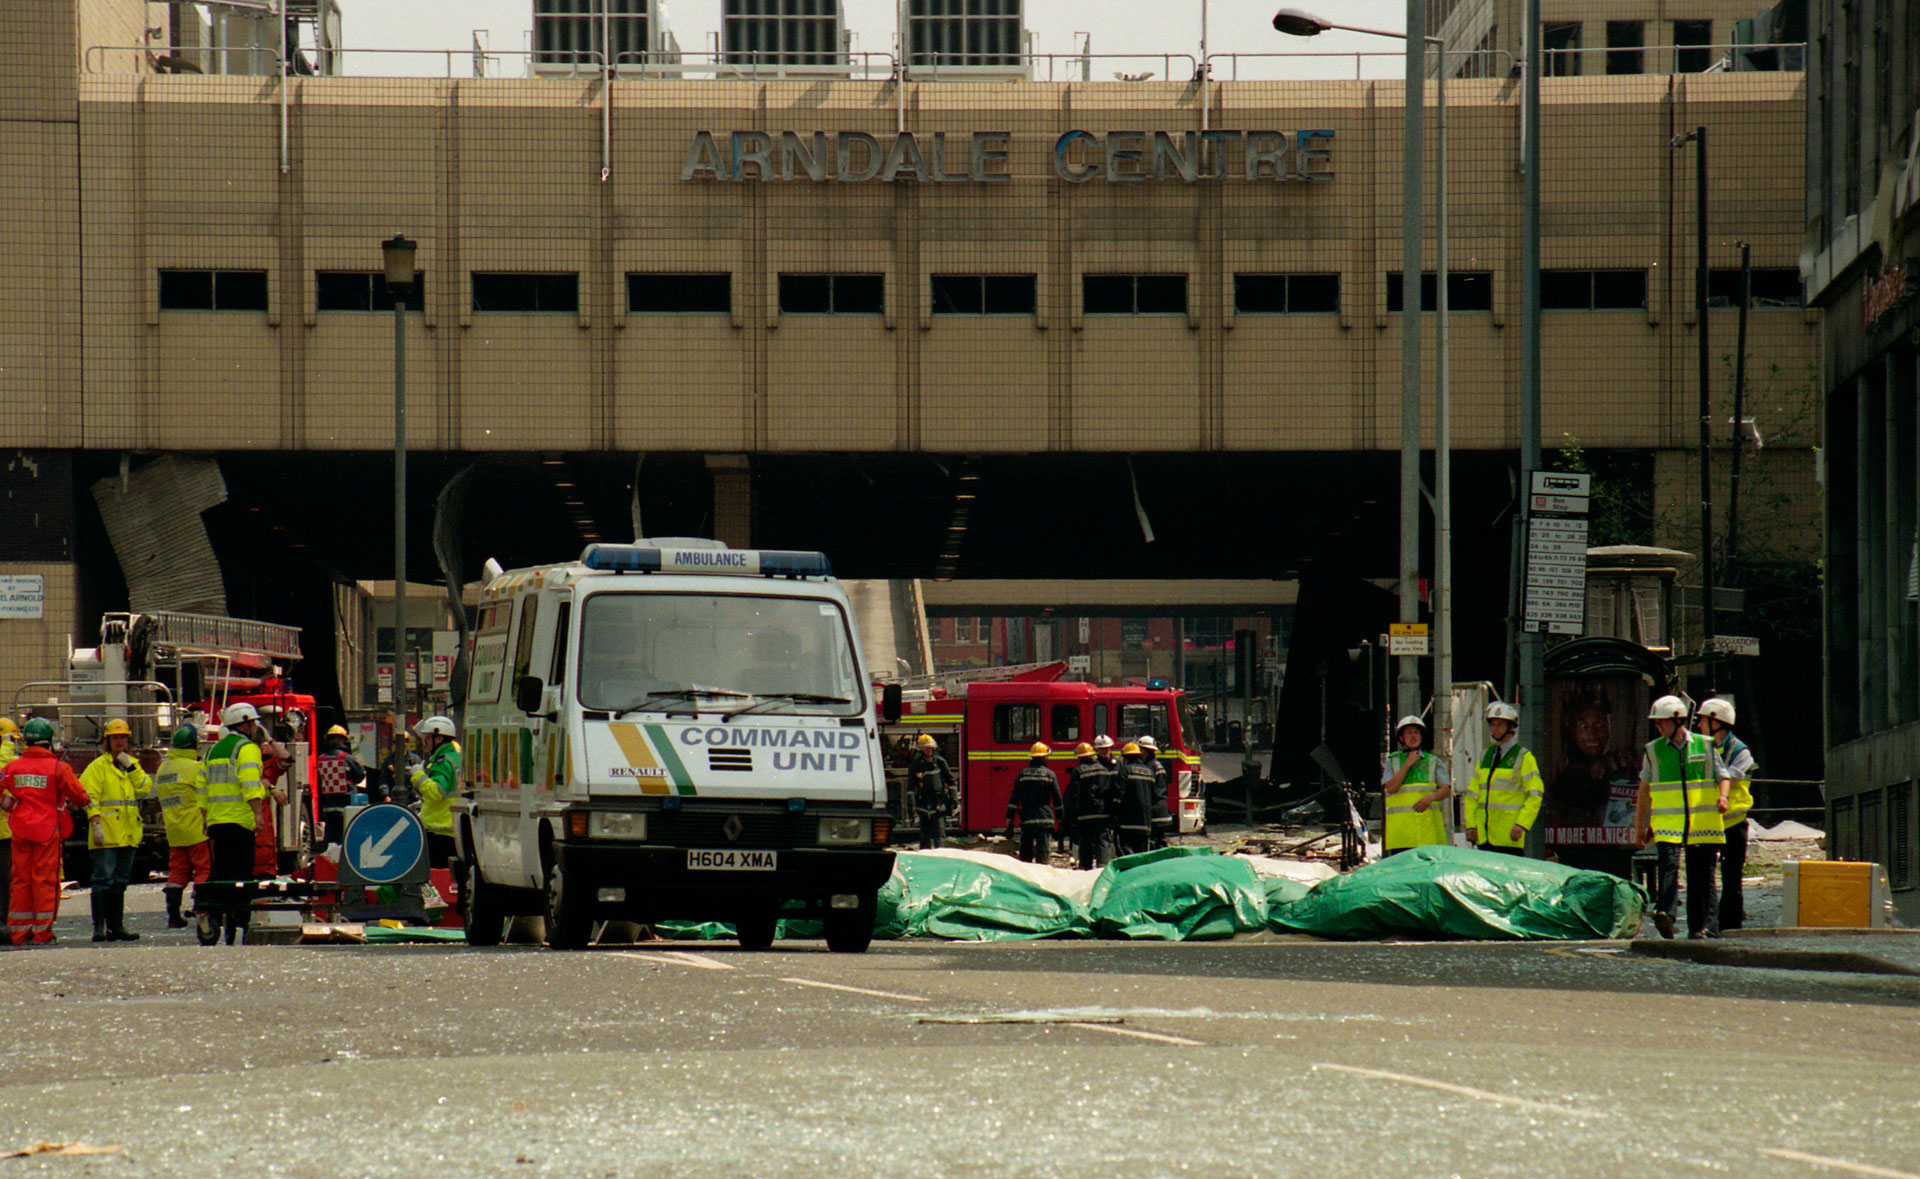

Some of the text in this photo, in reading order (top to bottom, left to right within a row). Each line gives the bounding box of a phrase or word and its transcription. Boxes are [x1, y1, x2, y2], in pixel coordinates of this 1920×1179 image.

[680, 130, 1336, 183] ARNDALE CENTRE
[674, 551, 747, 567] AMBULANCE
[9, 594, 44, 602] ARNOLD
[680, 727, 861, 750] COMMAND
[772, 752, 861, 773] UNIT
[610, 767, 667, 777] RENAULT
[15, 774, 47, 788] NURSE
[1557, 827, 1585, 844] MORE
[688, 852, 774, 869] H604 XMA
